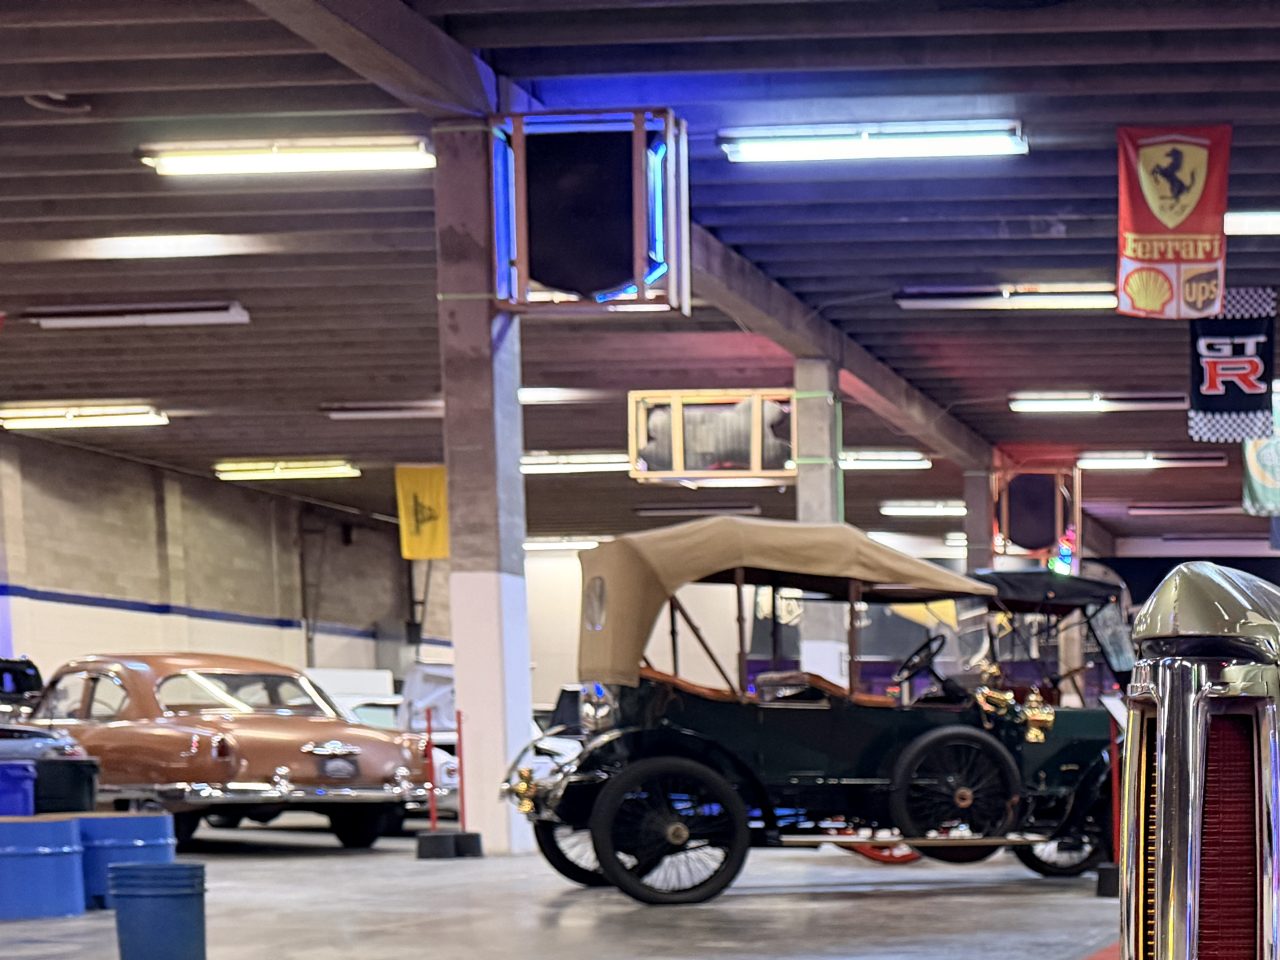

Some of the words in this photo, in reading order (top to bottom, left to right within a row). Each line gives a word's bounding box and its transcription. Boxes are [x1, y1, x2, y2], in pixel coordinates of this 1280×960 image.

[1124, 232, 1221, 260] Ferrari
[1185, 280, 1218, 309] ups
[1196, 334, 1268, 356] GT
[1199, 356, 1268, 395] R
